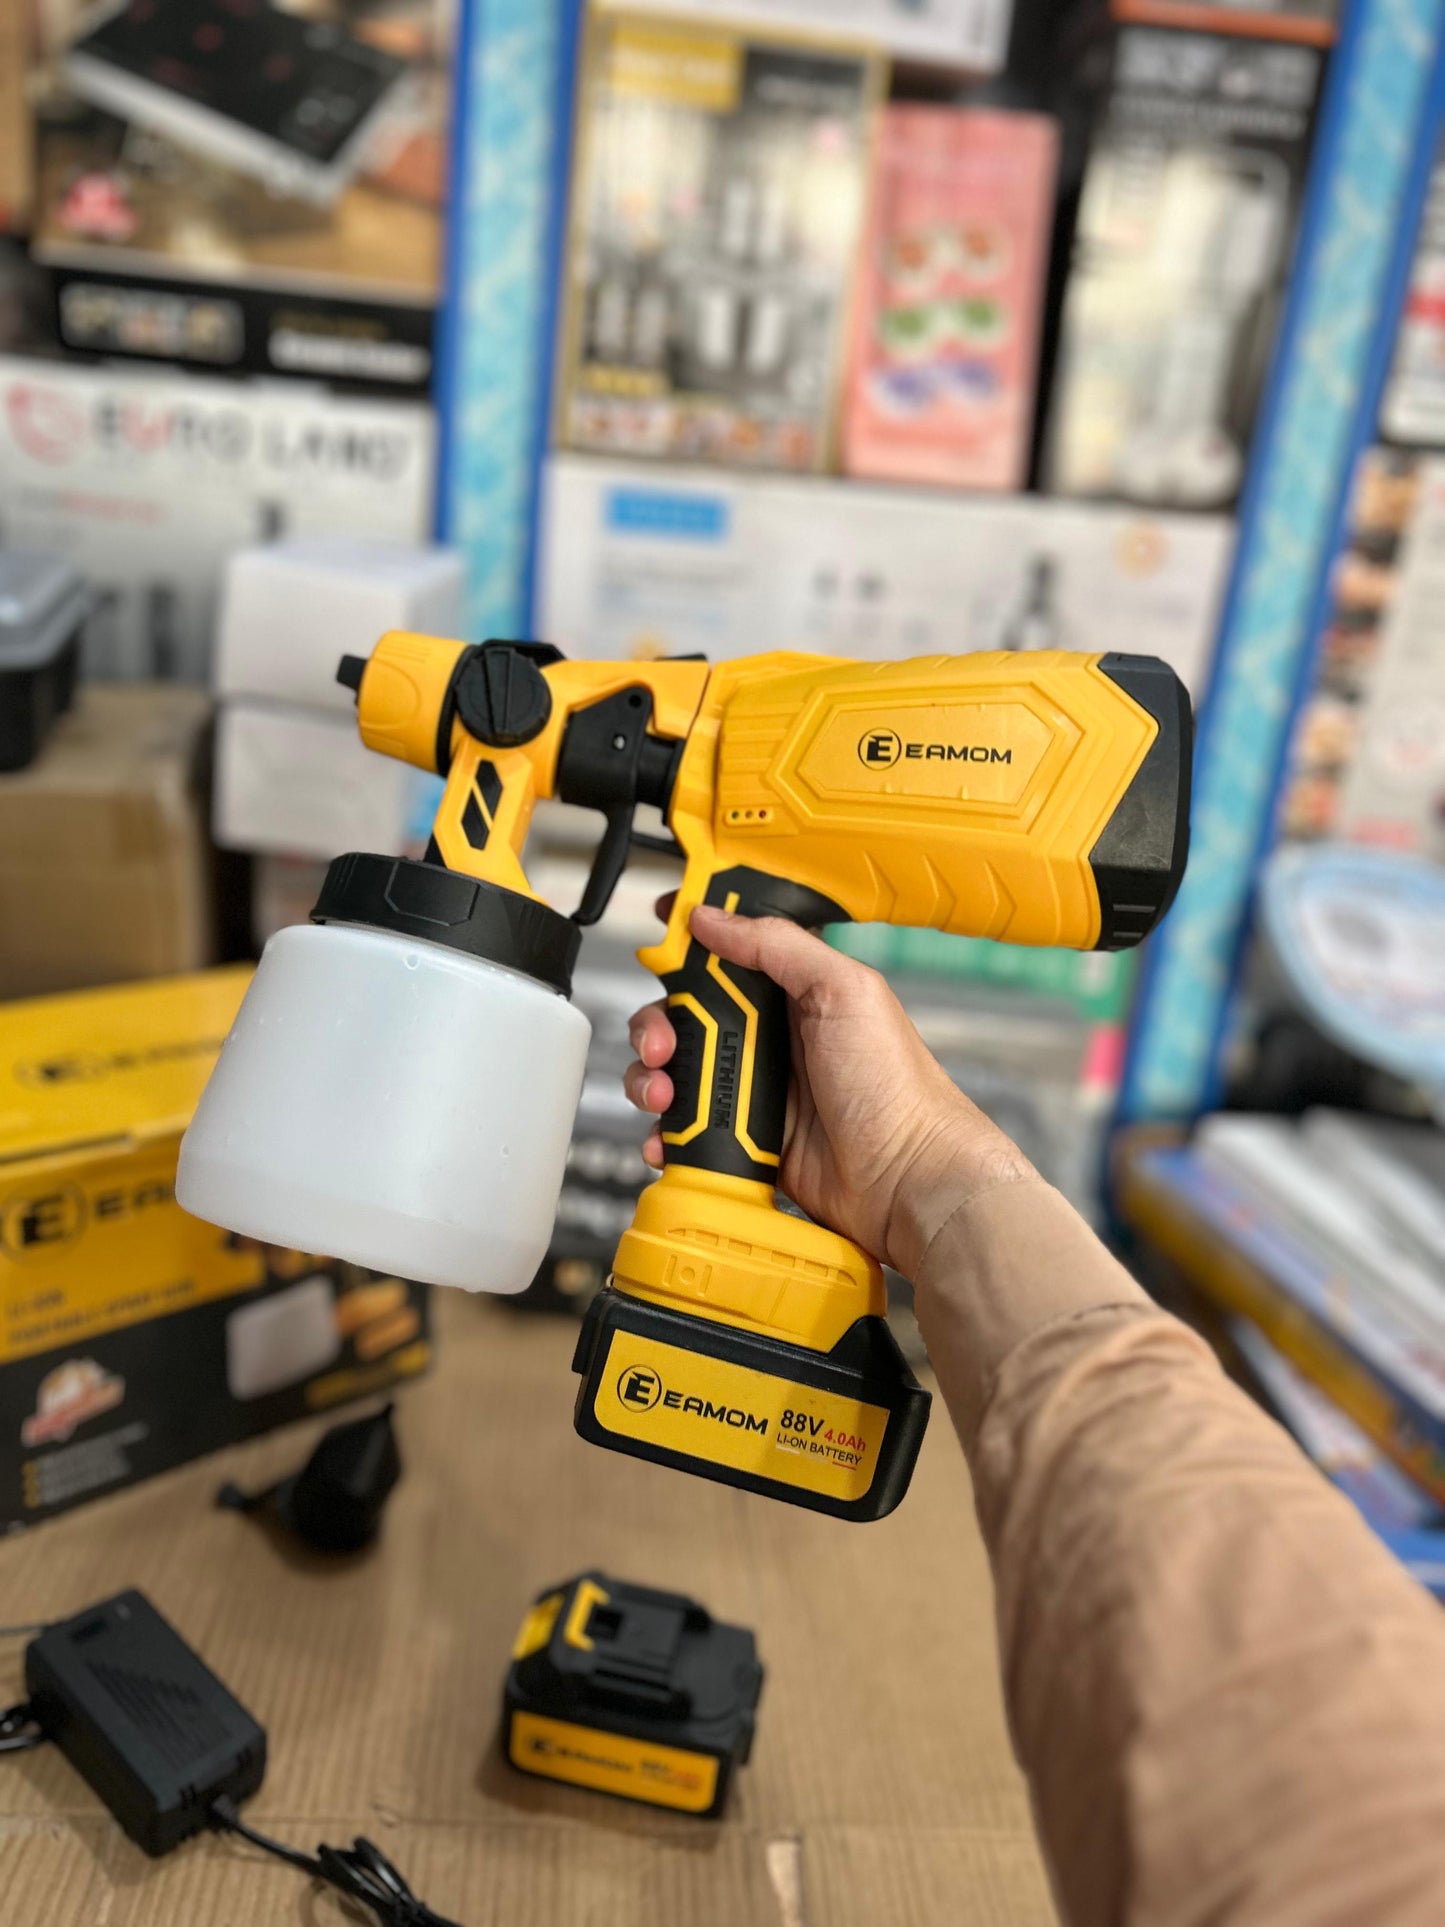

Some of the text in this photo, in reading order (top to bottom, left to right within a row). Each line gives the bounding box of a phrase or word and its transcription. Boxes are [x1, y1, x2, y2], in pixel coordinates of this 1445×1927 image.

[905, 743, 1012, 765] EAMOM
[713, 1031, 738, 1129] LITHIUM
[663, 1389, 768, 1435] EAMOM
[780, 1409, 867, 1452] 88V 4.0Ah
[776, 1432, 862, 1466] LI-ON BATTERY
